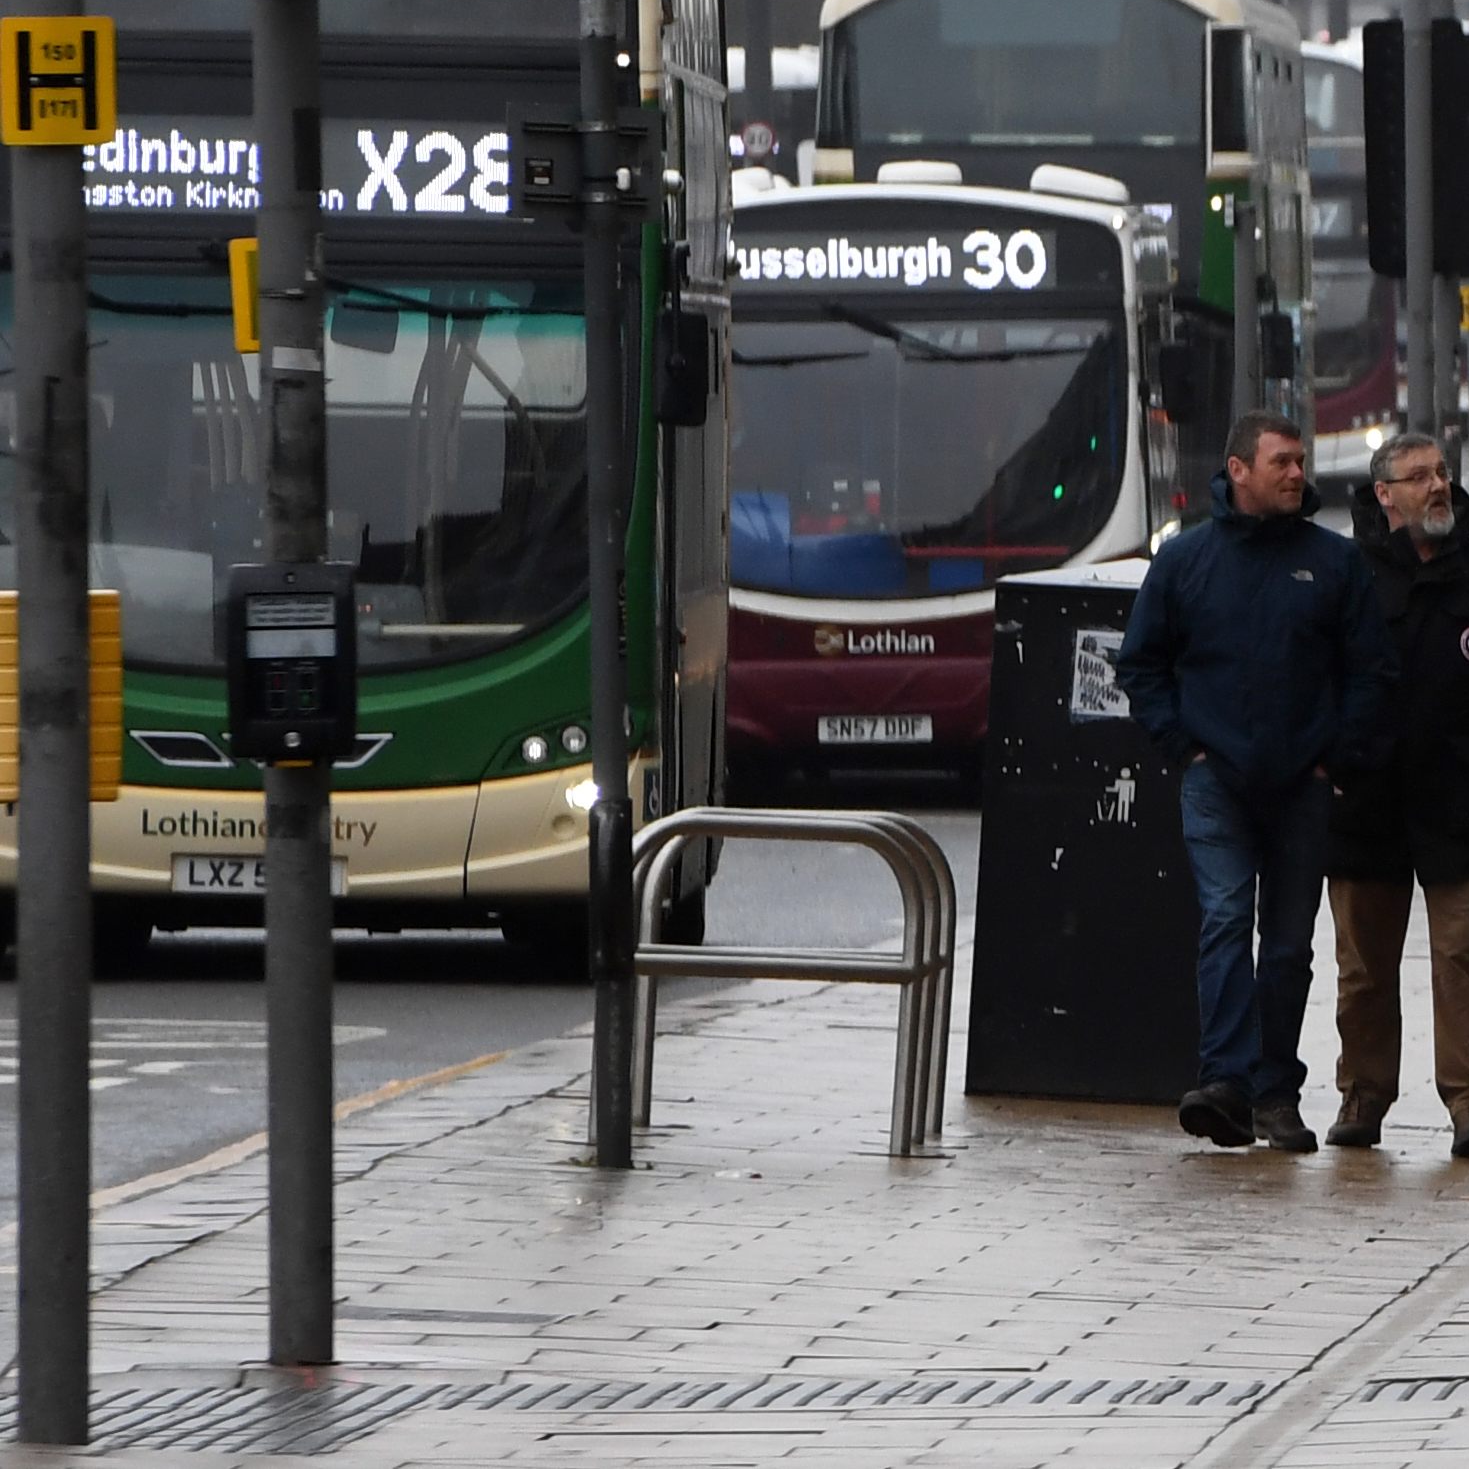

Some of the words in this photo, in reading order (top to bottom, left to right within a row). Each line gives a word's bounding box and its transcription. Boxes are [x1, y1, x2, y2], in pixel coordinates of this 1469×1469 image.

[41, 43, 76, 61] 150
[83, 129, 261, 184] dinbur
[357, 129, 512, 213] X28
[731, 236, 952, 286] usselburgh
[962, 230, 1047, 290] 30
[848, 628, 935, 654] Lothian
